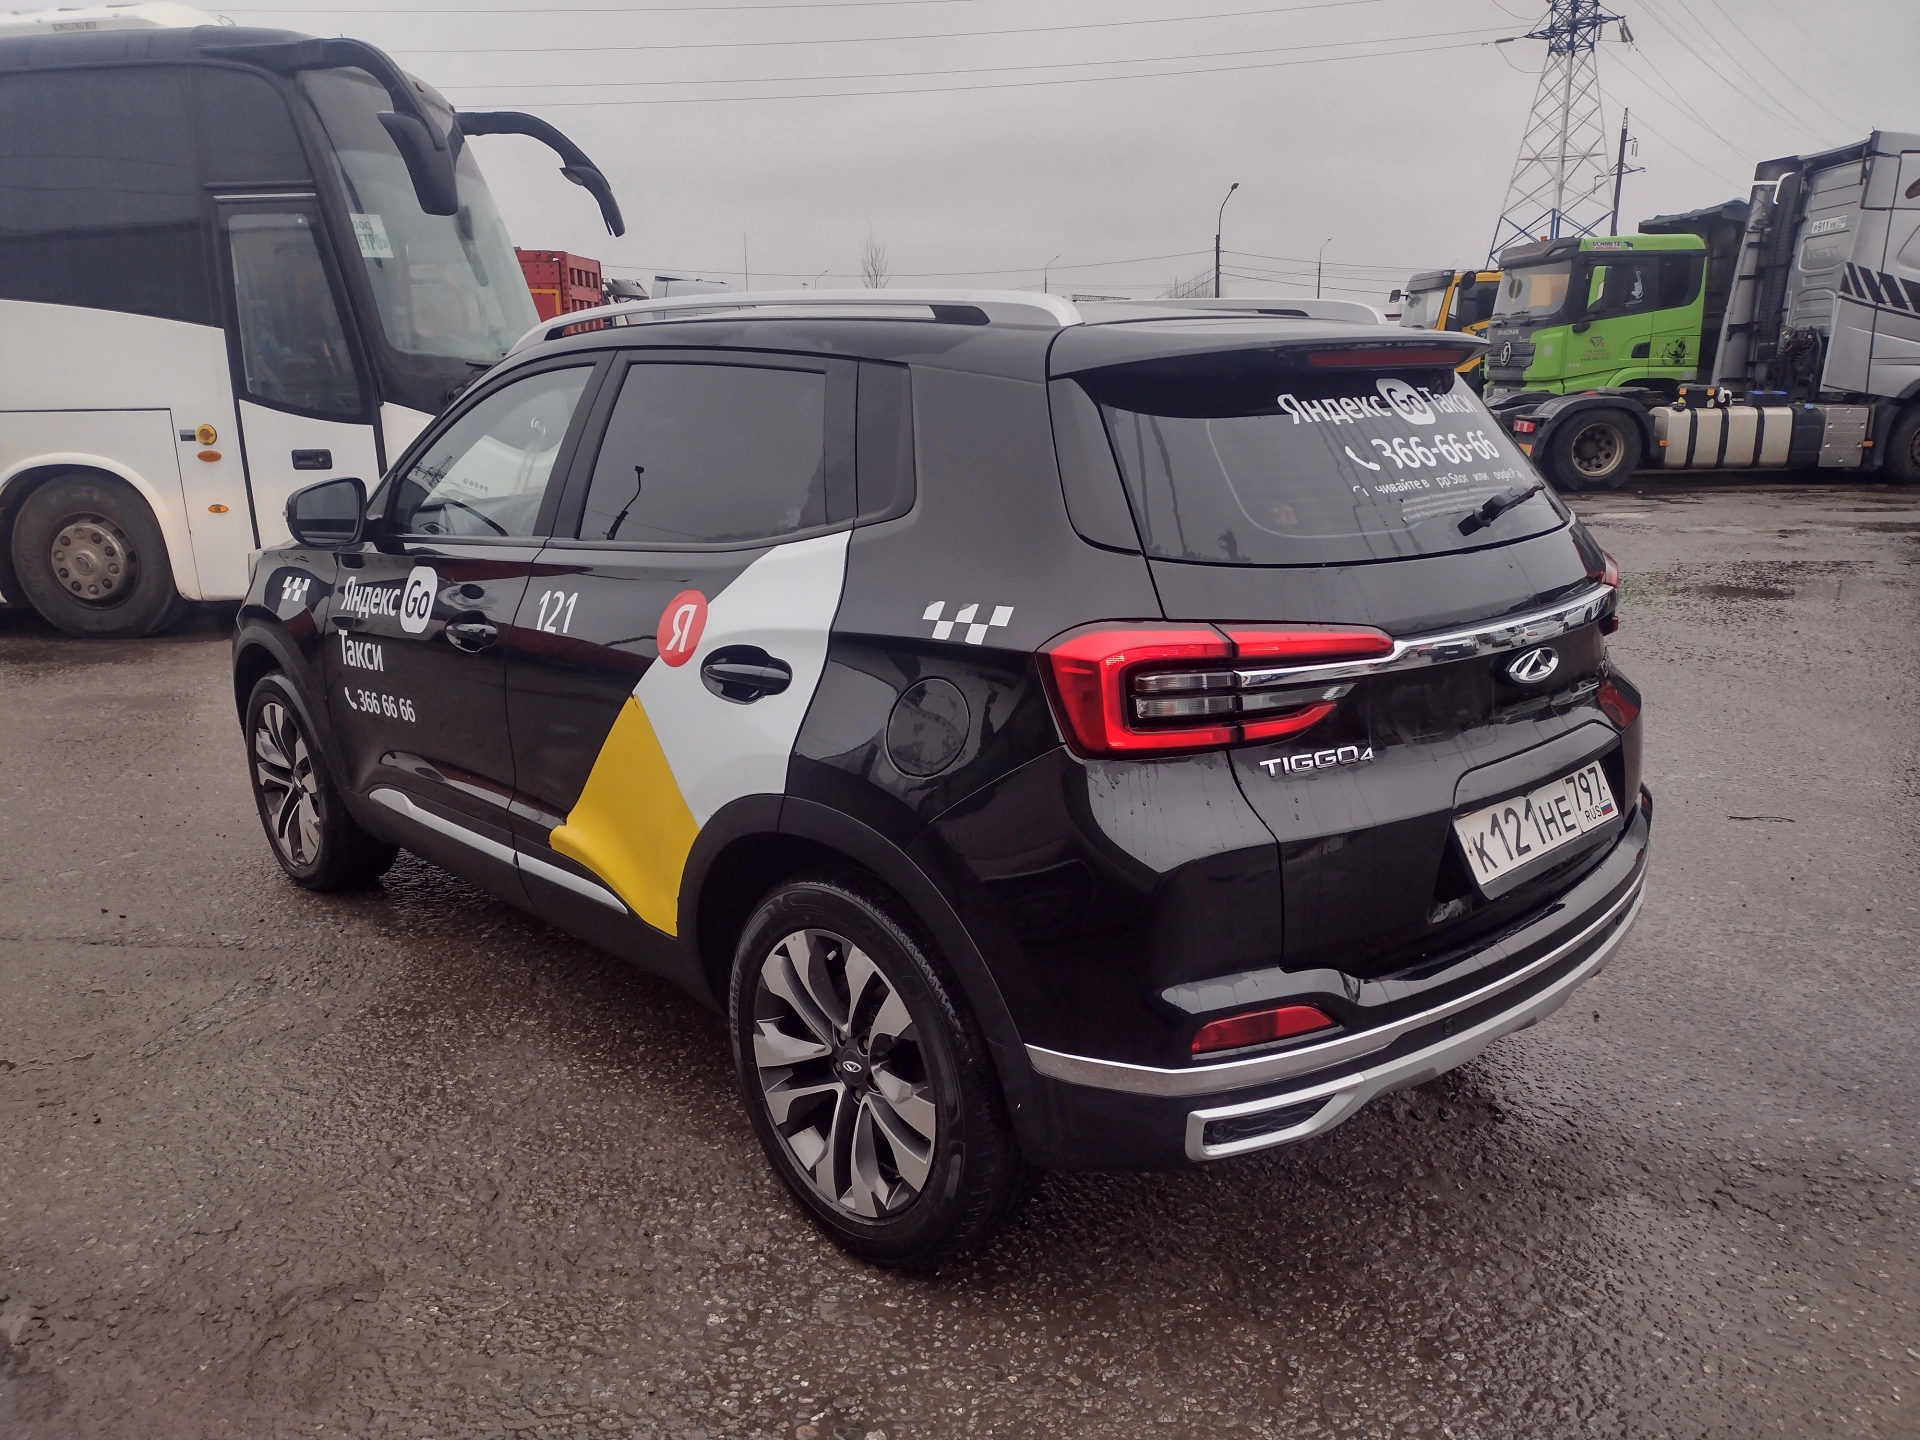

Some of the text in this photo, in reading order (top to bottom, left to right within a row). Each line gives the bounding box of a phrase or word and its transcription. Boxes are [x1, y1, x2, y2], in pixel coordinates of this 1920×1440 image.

[85, 21, 97, 30] BUS
[357, 233, 389, 251] ЕТРО»
[1277, 393, 1393, 425] Яндекс
[1417, 386, 1478, 414] Такси
[1371, 430, 1500, 469] 366-66-66
[1421, 479, 1430, 488] в
[1448, 472, 1470, 485] Stor
[1472, 471, 1490, 482] или
[341, 576, 431, 620] Яндекс Go
[536, 590, 579, 634] 121
[665, 603, 698, 653] Я
[338, 629, 384, 672] Такси
[357, 689, 416, 723] 366 66 66
[1584, 805, 1602, 822] RUS
